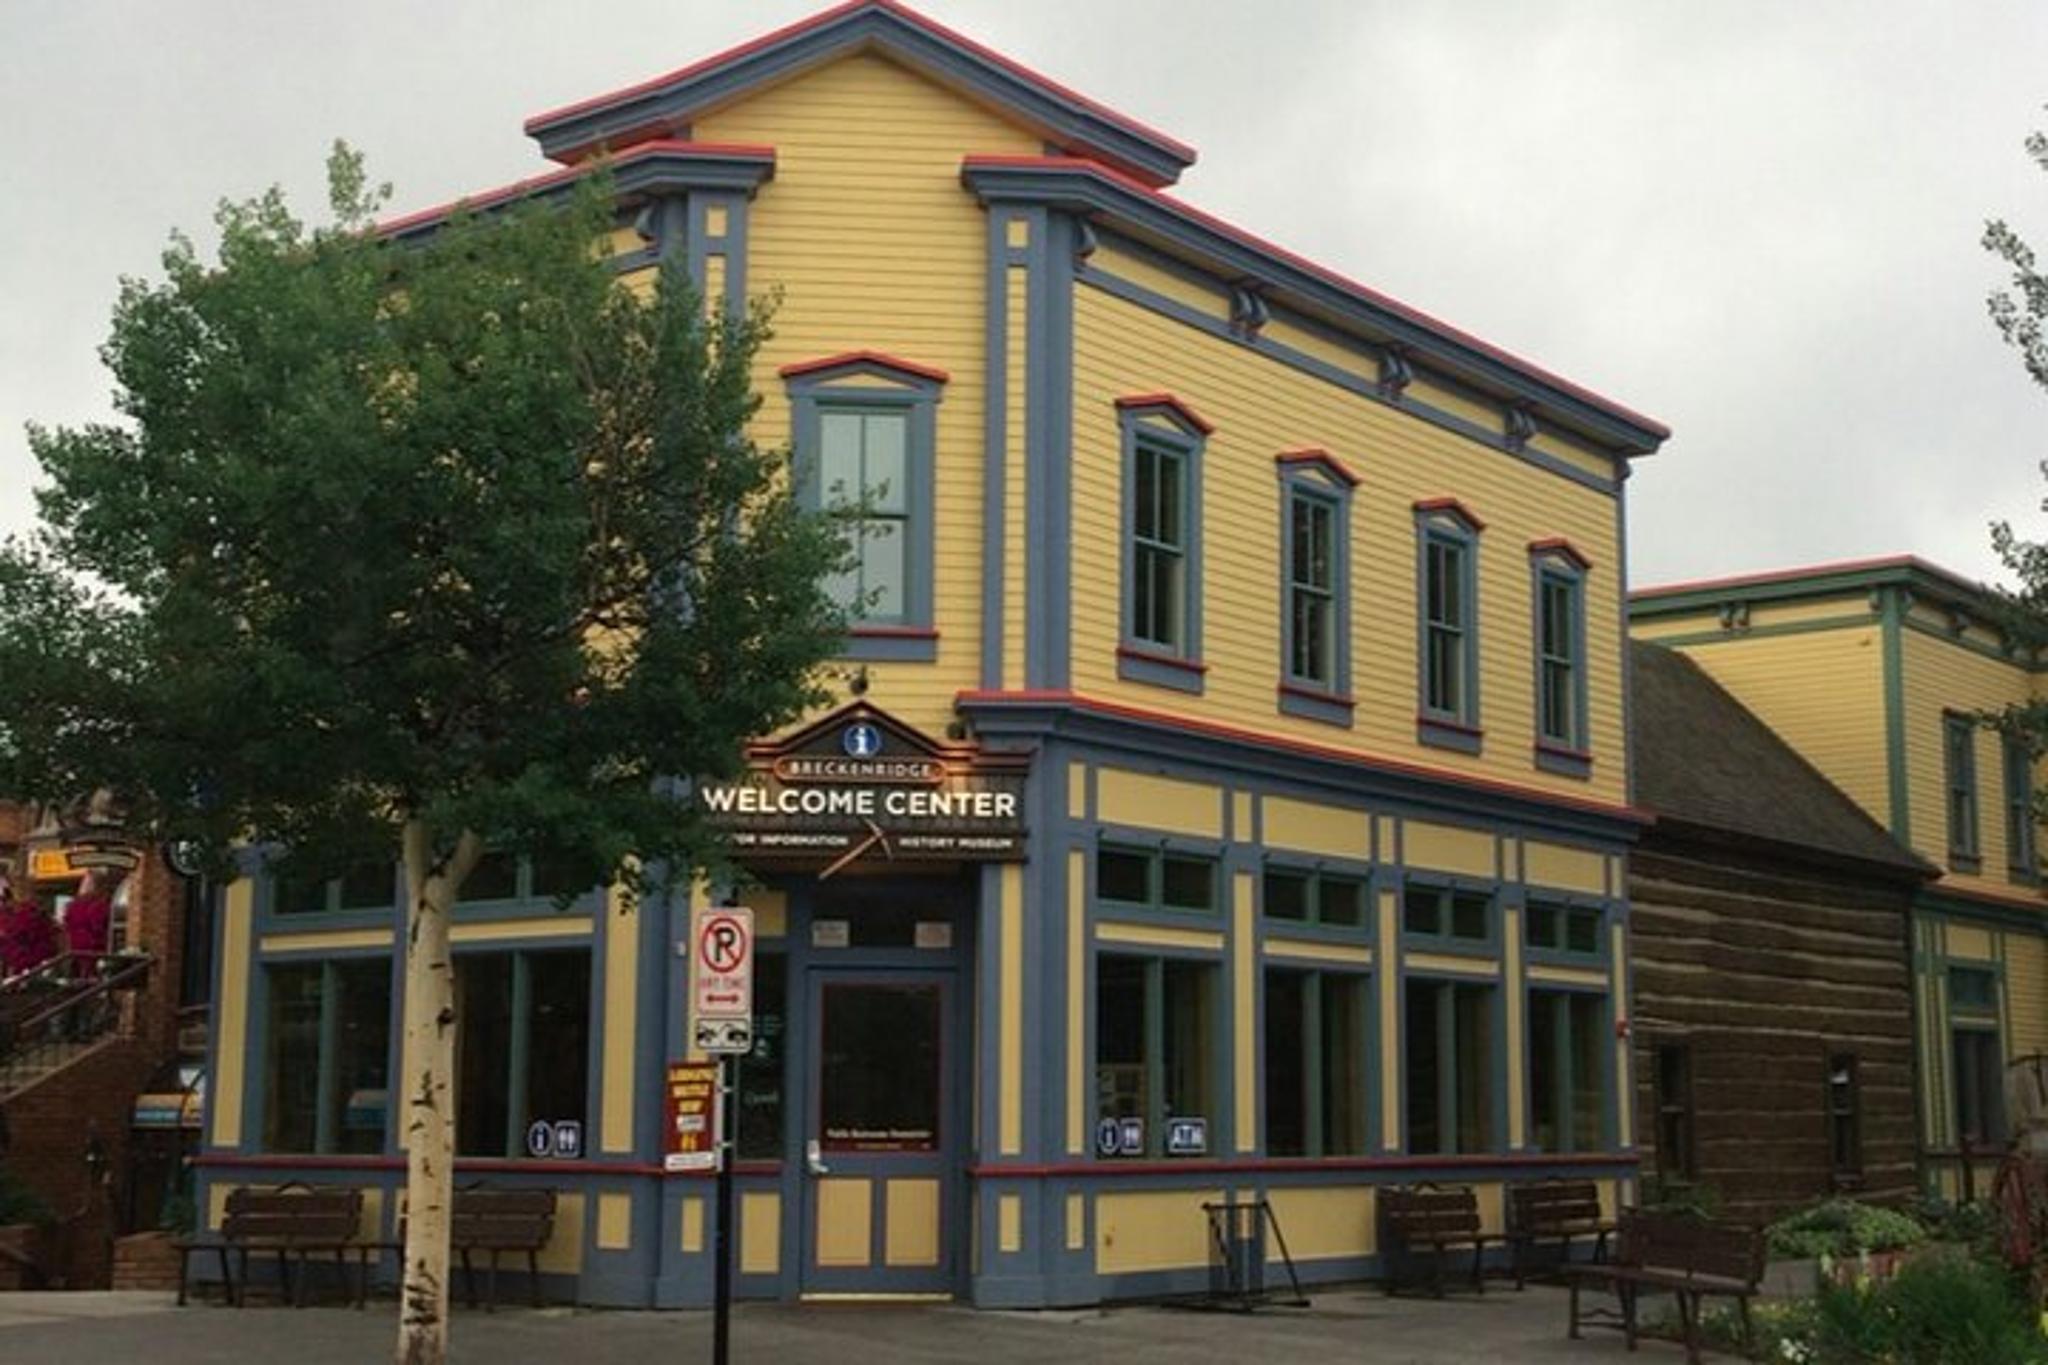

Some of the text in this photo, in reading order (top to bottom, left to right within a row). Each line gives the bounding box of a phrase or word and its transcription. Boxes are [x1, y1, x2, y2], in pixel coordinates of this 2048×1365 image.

[789, 761, 930, 777] BRECKENRIDGE
[702, 787, 1016, 817] WELCOME CENTER
[760, 833, 848, 846] INFORMATION
[899, 836, 1013, 849] HISTORY MUSEUM
[1173, 1125, 1204, 1146] ATM
